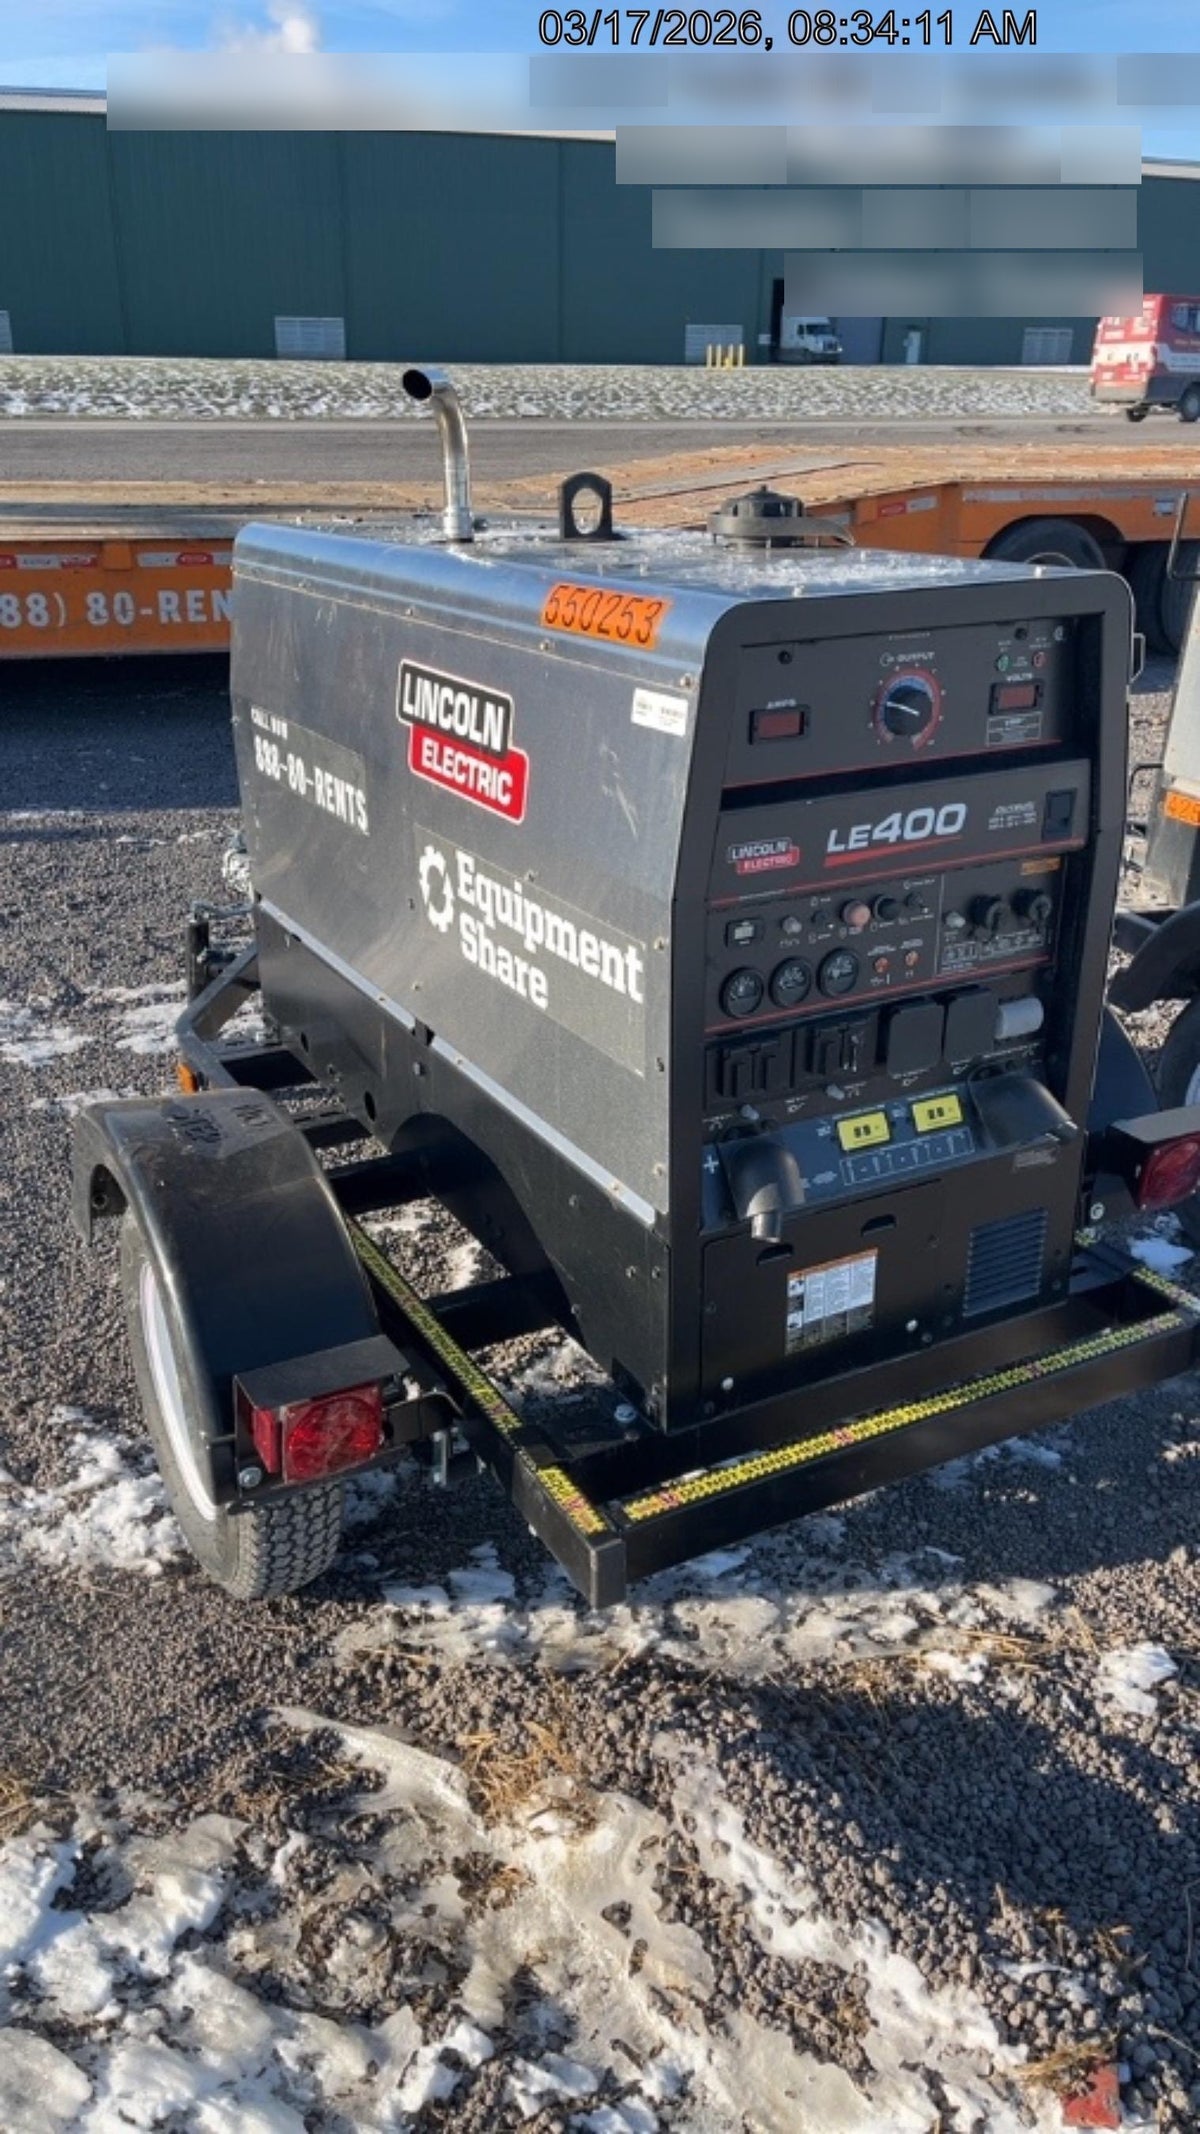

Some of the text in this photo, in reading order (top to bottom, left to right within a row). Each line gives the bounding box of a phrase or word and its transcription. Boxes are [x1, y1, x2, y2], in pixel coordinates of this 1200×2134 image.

[545, 585, 663, 643] 550253
[402, 672, 504, 752] LINCOLN
[254, 734, 369, 837] 888-80-RENTS
[421, 736, 513, 807] ELECTRIC
[732, 841, 788, 860] LINCOLN
[743, 853, 794, 870] ELECTRIC
[826, 803, 967, 853] LE400
[455, 849, 645, 1004] Equipment
[459, 911, 549, 1010] Share
